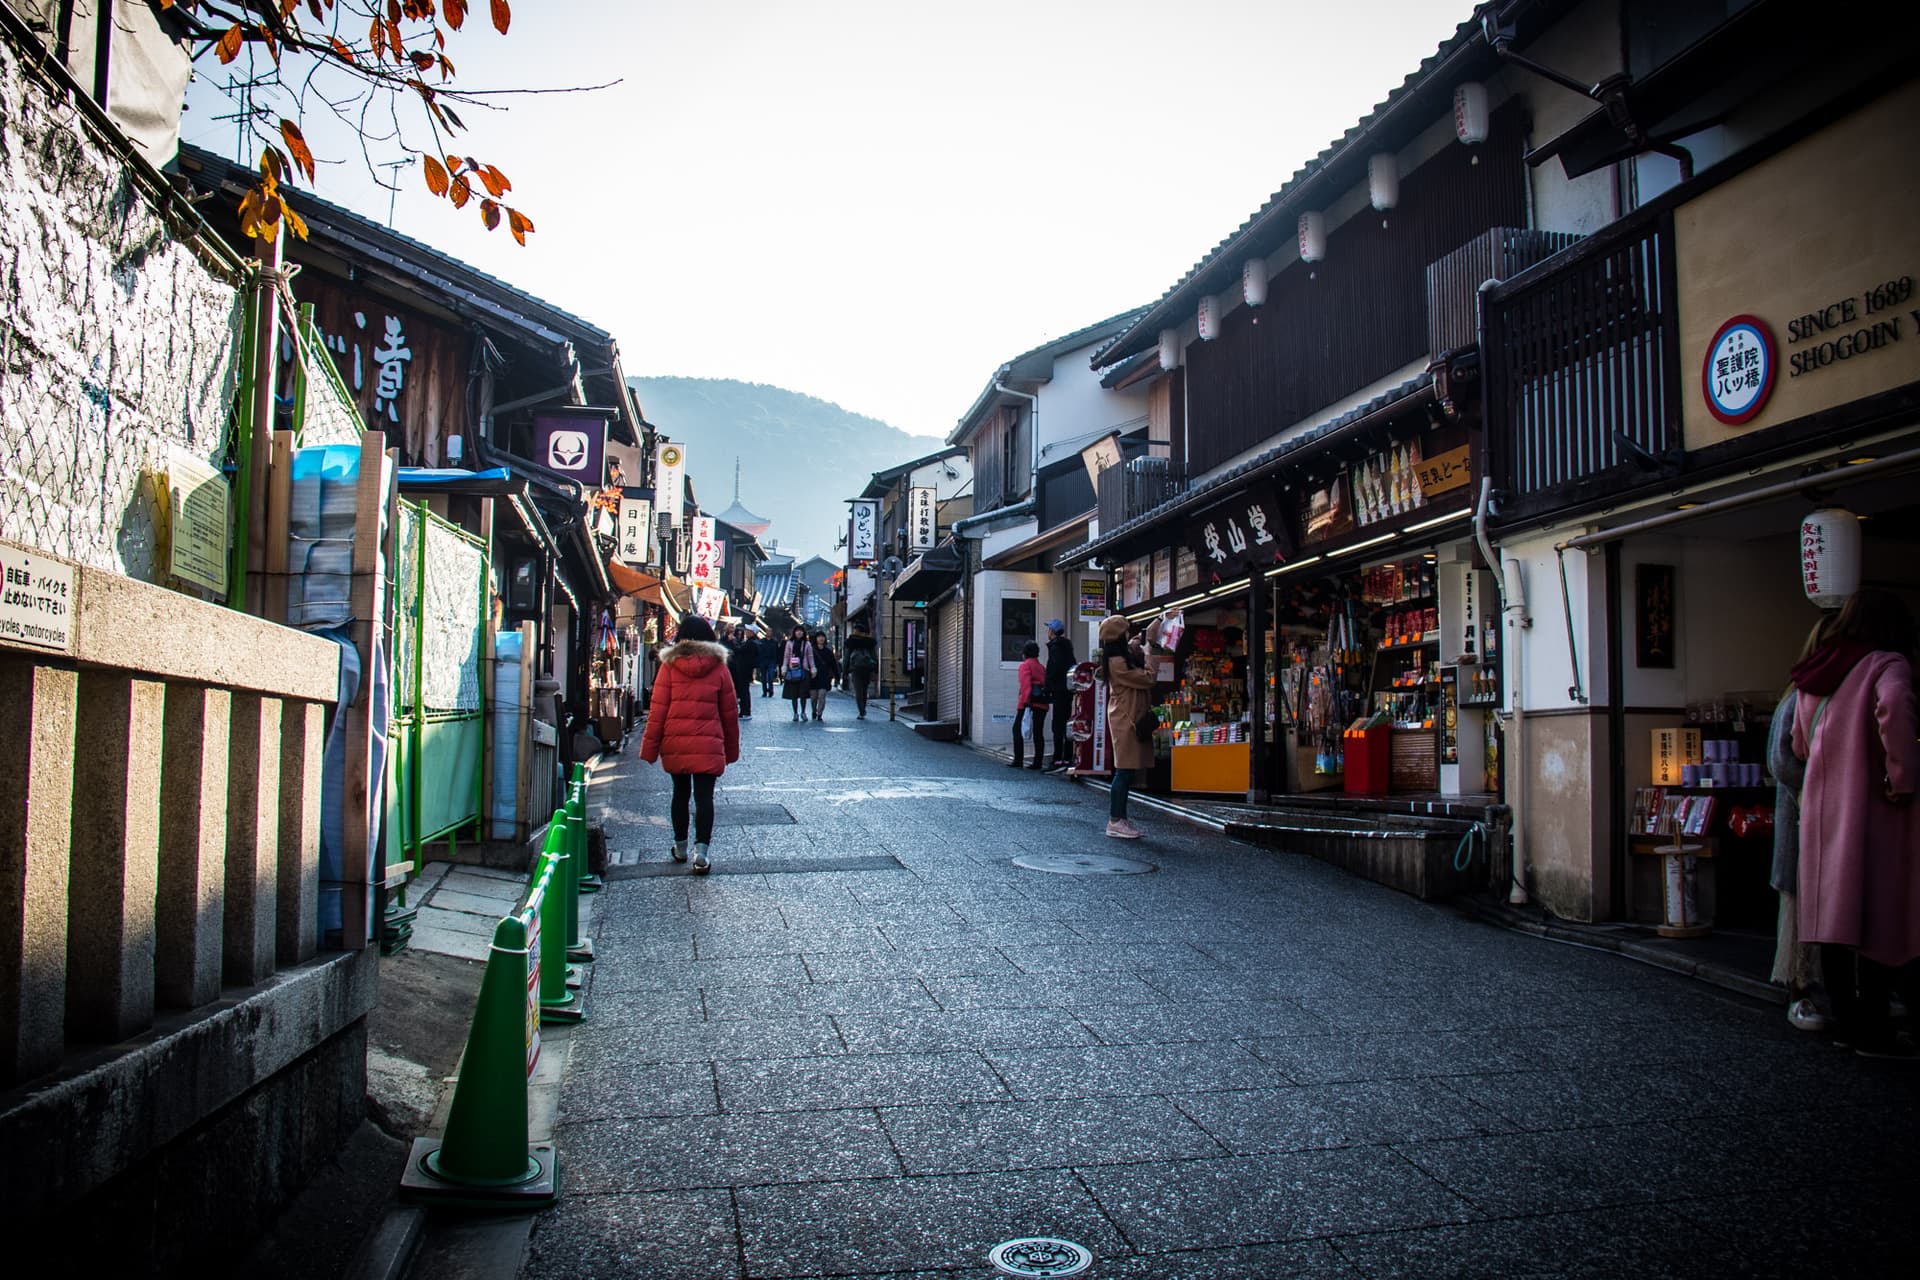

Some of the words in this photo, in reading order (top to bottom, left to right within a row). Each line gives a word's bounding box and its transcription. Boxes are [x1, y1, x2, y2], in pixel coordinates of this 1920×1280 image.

[1788, 297, 1857, 344] SINCE
[1864, 276, 1912, 315] 1689
[1716, 346, 1759, 379] 聖護院
[1790, 316, 1902, 377] SHOGOIN
[1717, 367, 1760, 398] 八ツ橋
[624, 509, 637, 555] 日月庵
[6, 566, 68, 597] 自転車・バイクを
[3, 587, 66, 615] 止めないで下さい
[24, 623, 65, 643] motorcycles
